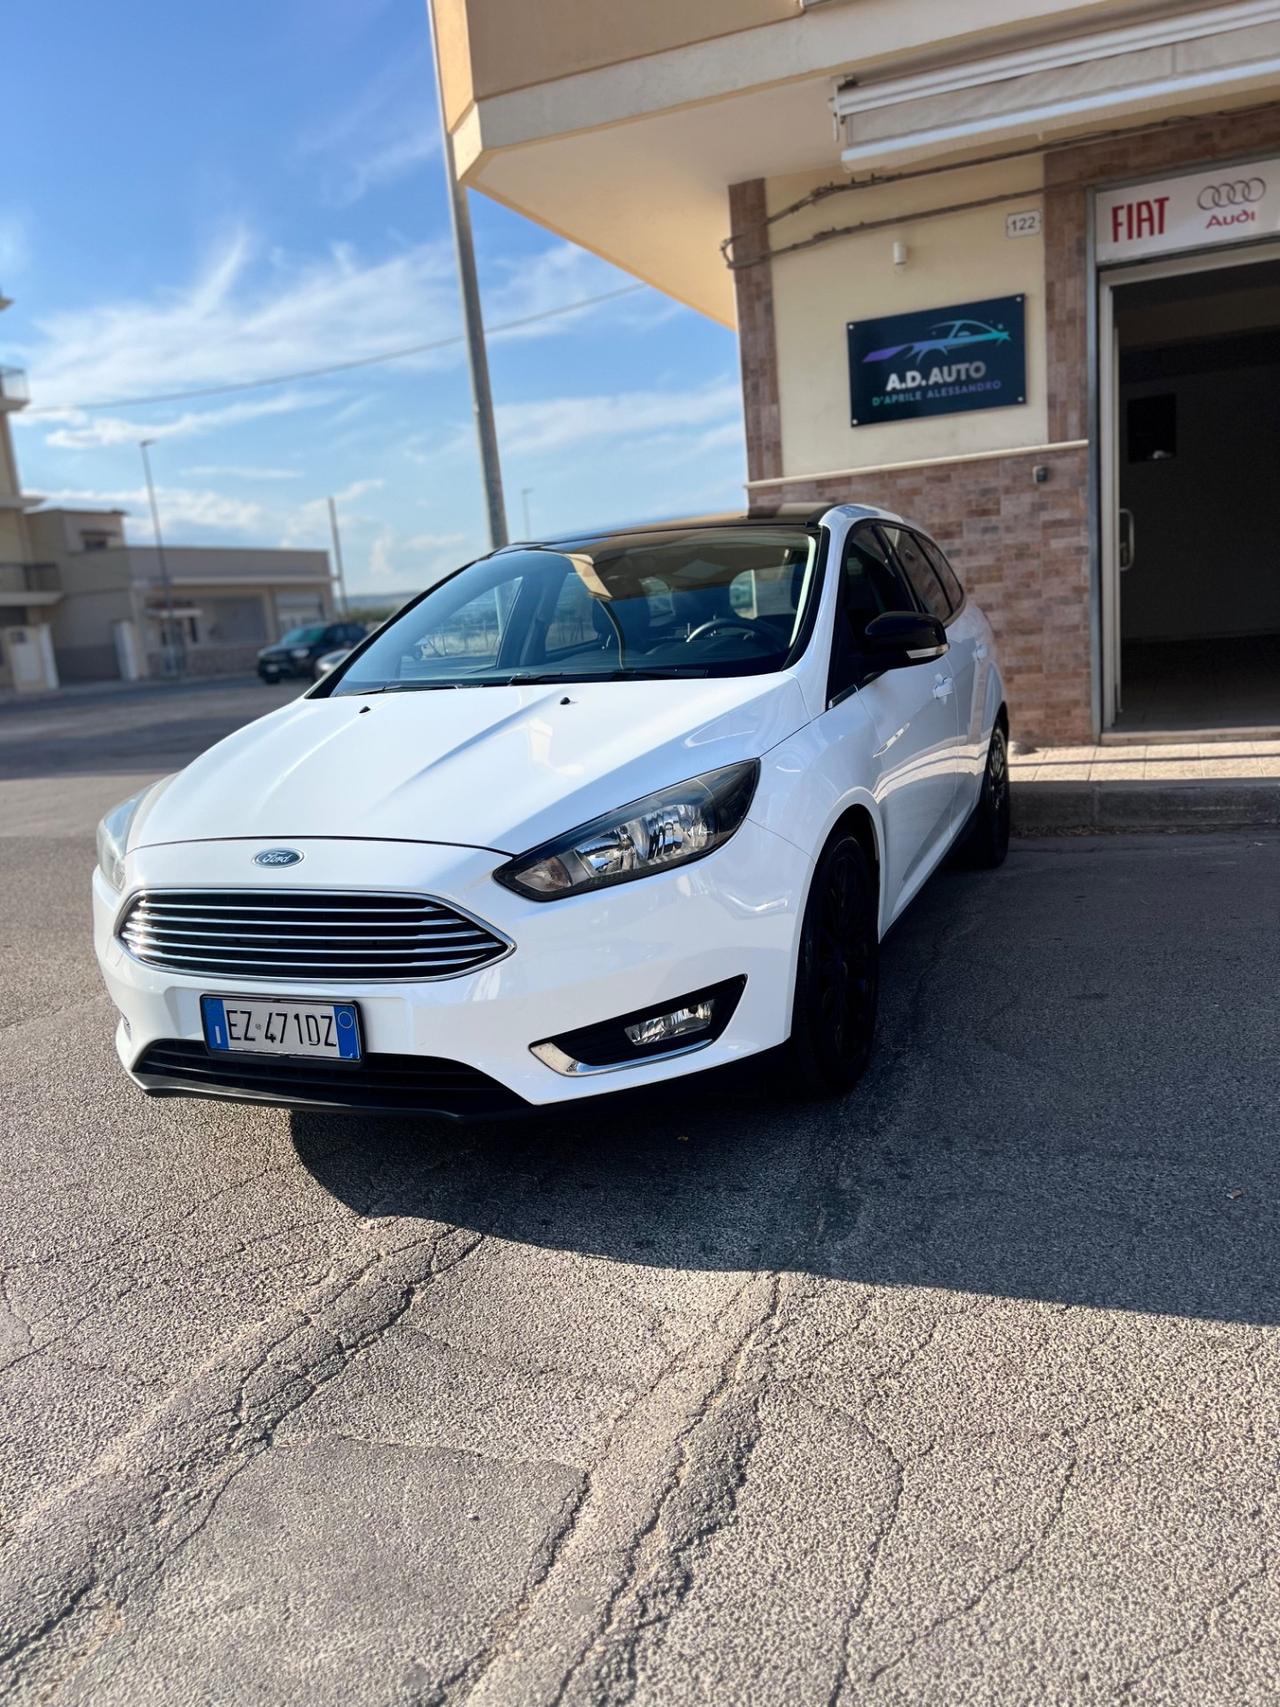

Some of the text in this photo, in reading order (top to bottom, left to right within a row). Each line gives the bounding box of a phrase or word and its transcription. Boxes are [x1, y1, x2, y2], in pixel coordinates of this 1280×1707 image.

[1011, 216, 1036, 232] 122
[1111, 196, 1171, 243] FIAT
[1205, 209, 1256, 229] Audi
[928, 361, 987, 385] AUTO
[871, 379, 1002, 407] D'APRILE ALESSANDRO
[262, 851, 293, 863] Ford
